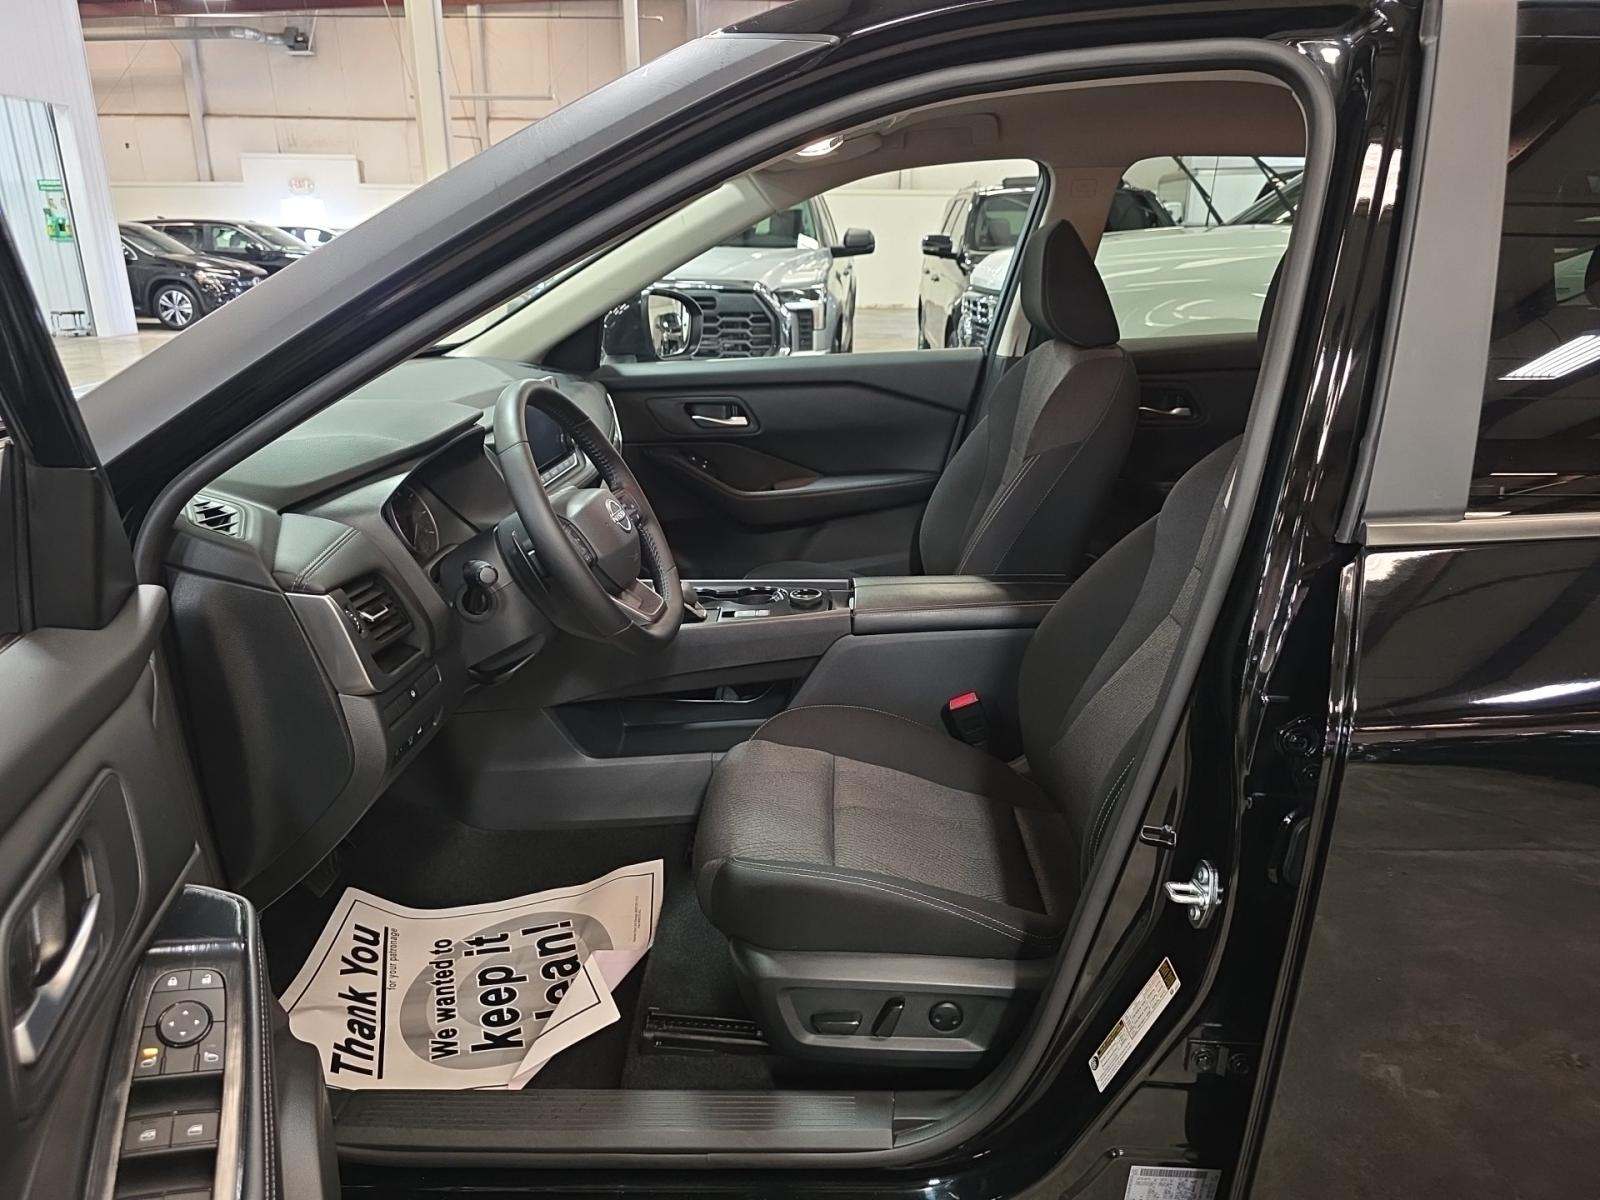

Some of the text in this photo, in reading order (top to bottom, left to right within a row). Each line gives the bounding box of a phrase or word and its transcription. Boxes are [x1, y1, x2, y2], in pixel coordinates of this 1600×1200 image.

[330, 923, 380, 1076] Thank You
[386, 928, 399, 991] for your patronage
[428, 939, 459, 1060] We wanted to
[463, 933, 527, 1052] keep it
[521, 920, 581, 1020] ean!
